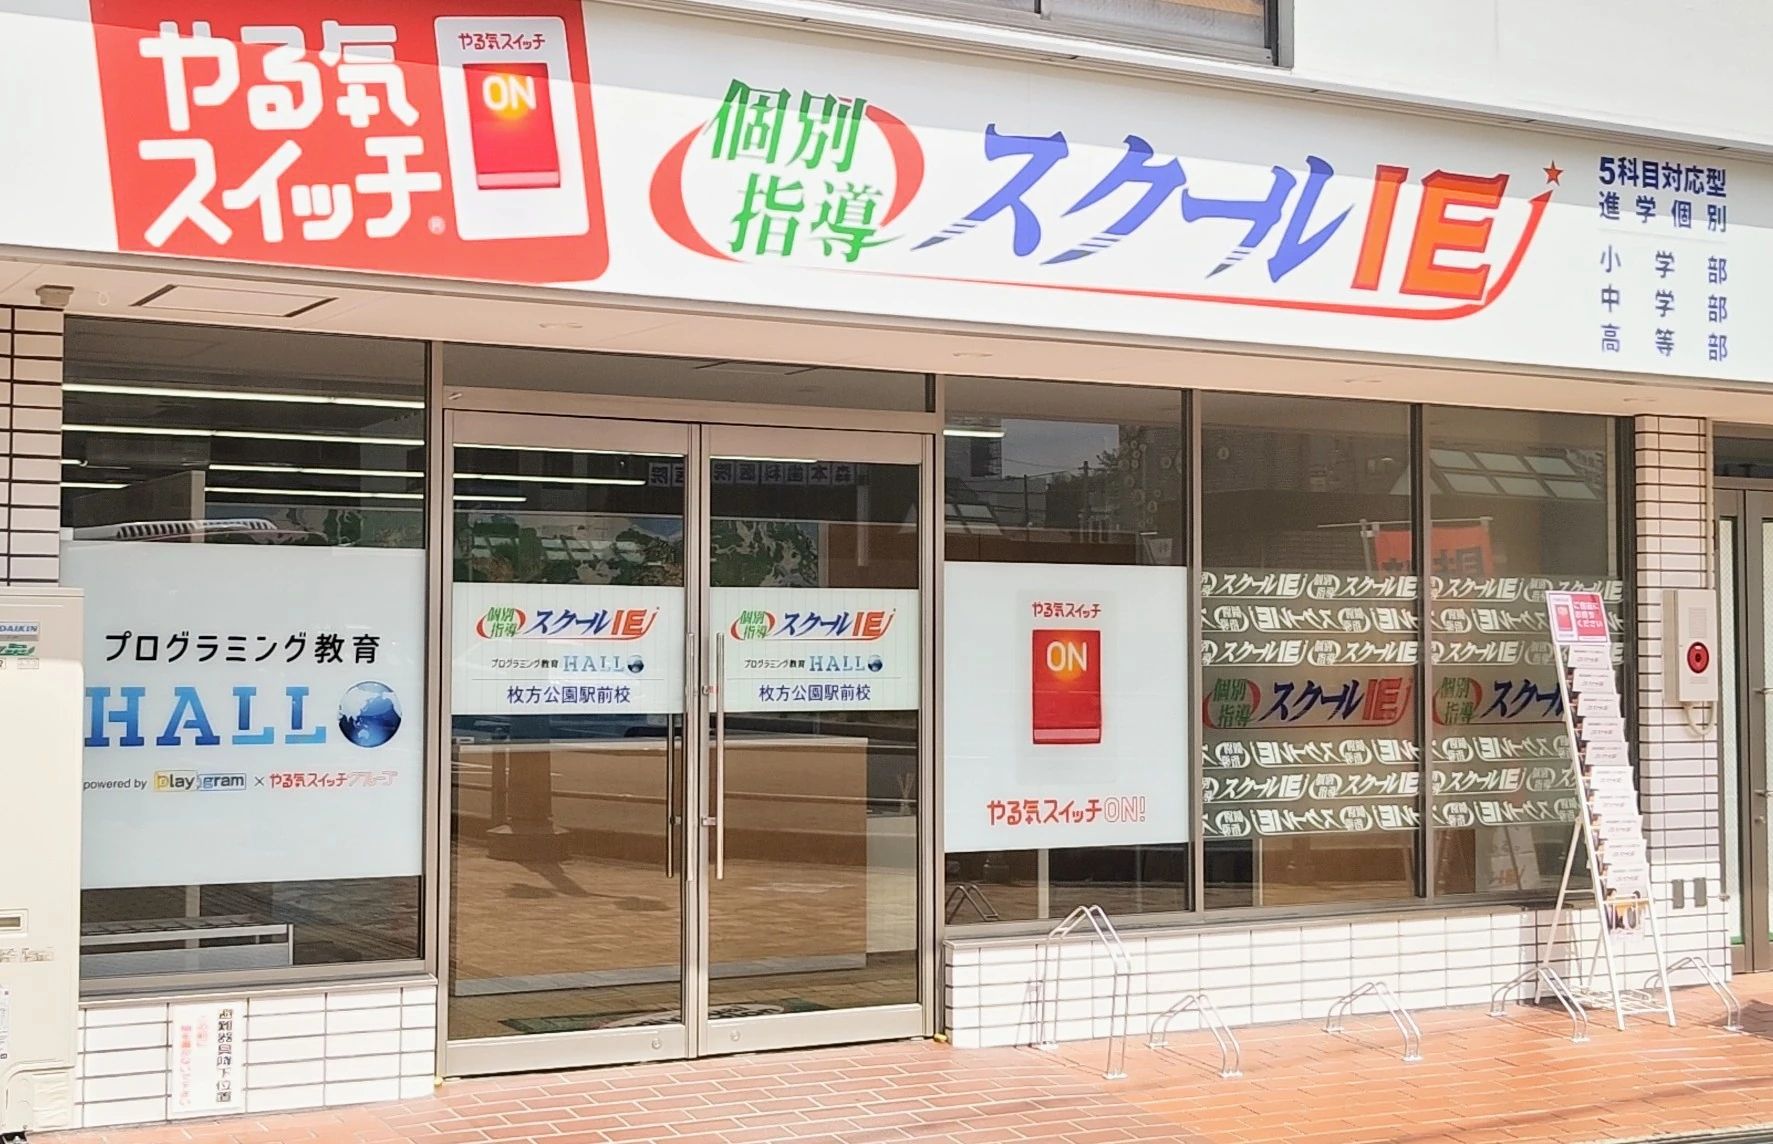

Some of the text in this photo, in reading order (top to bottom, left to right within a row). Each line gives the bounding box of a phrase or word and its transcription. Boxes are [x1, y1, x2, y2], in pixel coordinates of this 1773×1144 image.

[458, 32, 545, 50] やる気スイッチ
[139, 20, 419, 132] やる気
[482, 74, 537, 110] ON
[706, 78, 867, 173] 個別
[138, 136, 442, 247] スイッチ
[1599, 156, 1727, 198] 5科目対応型
[729, 172, 897, 262] 指導
[1599, 191, 1727, 233] 進学個別
[1600, 244, 1728, 285] 小学部
[1601, 283, 1728, 323] 中学部
[1601, 323, 1728, 361] 高等部
[1032, 602, 1101, 619] やる気スイッチ
[105, 630, 381, 664] プログラミング教育
[1047, 641, 1088, 671] ON
[507, 685, 632, 704] 枚方公園駅前校
[759, 684, 871, 702] 枚方公園駅前校
[83, 779, 131, 790] powered
[134, 778, 148, 790] by
